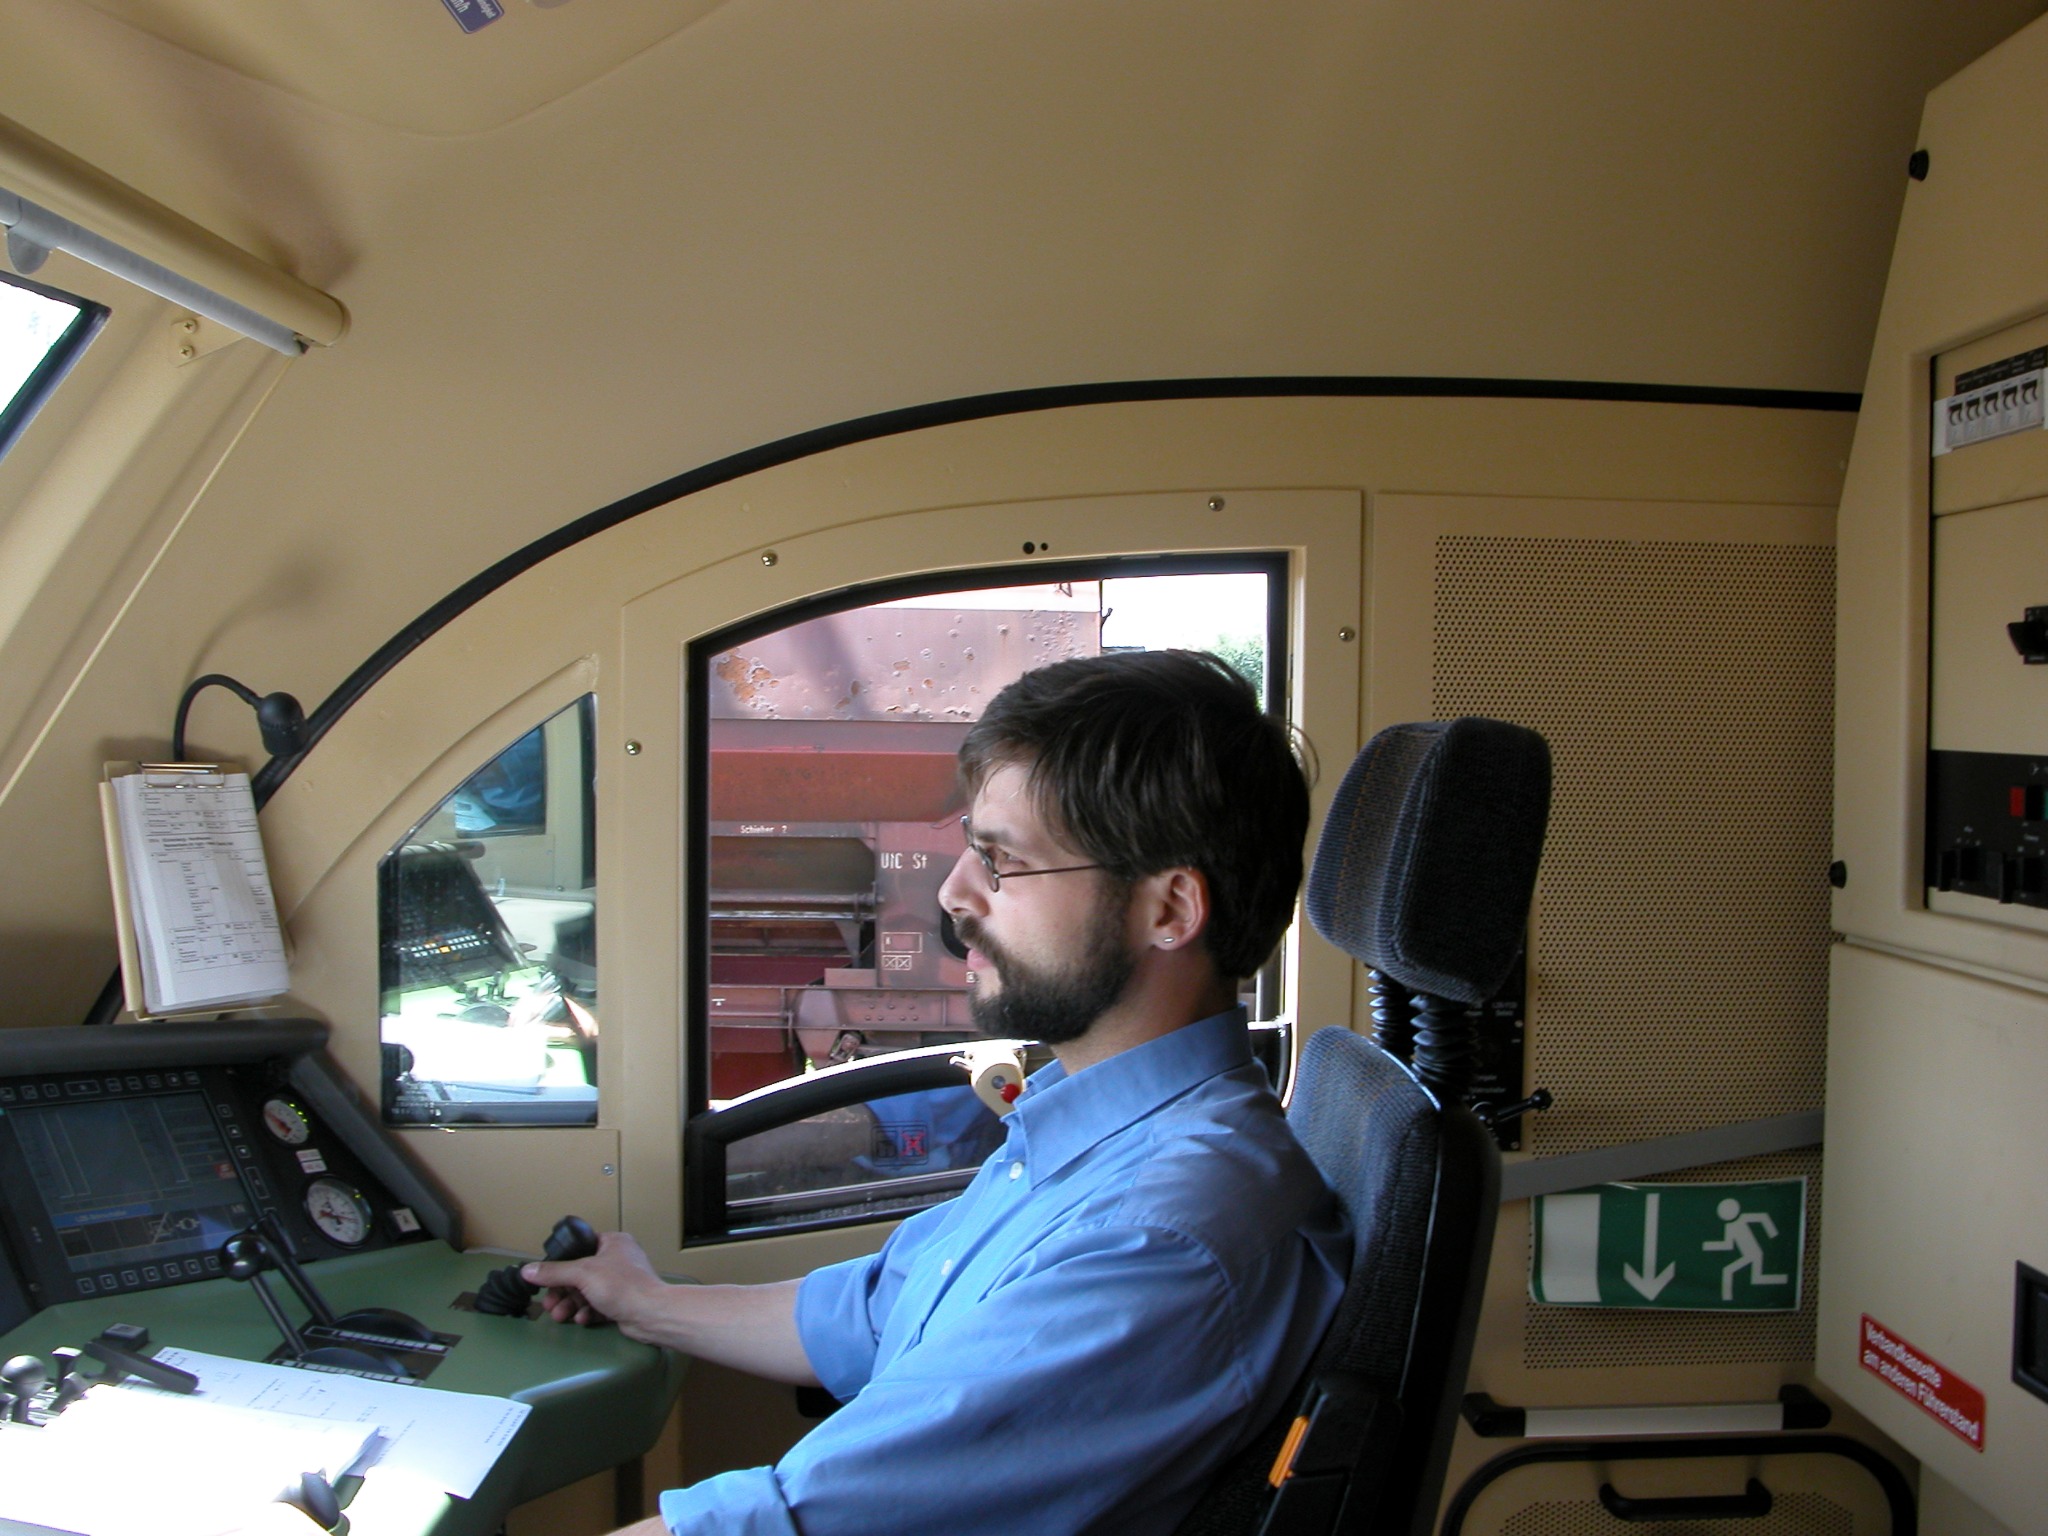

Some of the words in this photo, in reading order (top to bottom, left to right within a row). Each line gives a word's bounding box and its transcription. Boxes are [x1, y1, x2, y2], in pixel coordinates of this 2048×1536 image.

[880, 852, 903, 869] UIC
[912, 852, 928, 869] St
[1864, 1350, 1879, 1370] am
[1880, 1361, 1917, 1397] anderen
[1918, 1381, 1980, 1441] Führerstand
